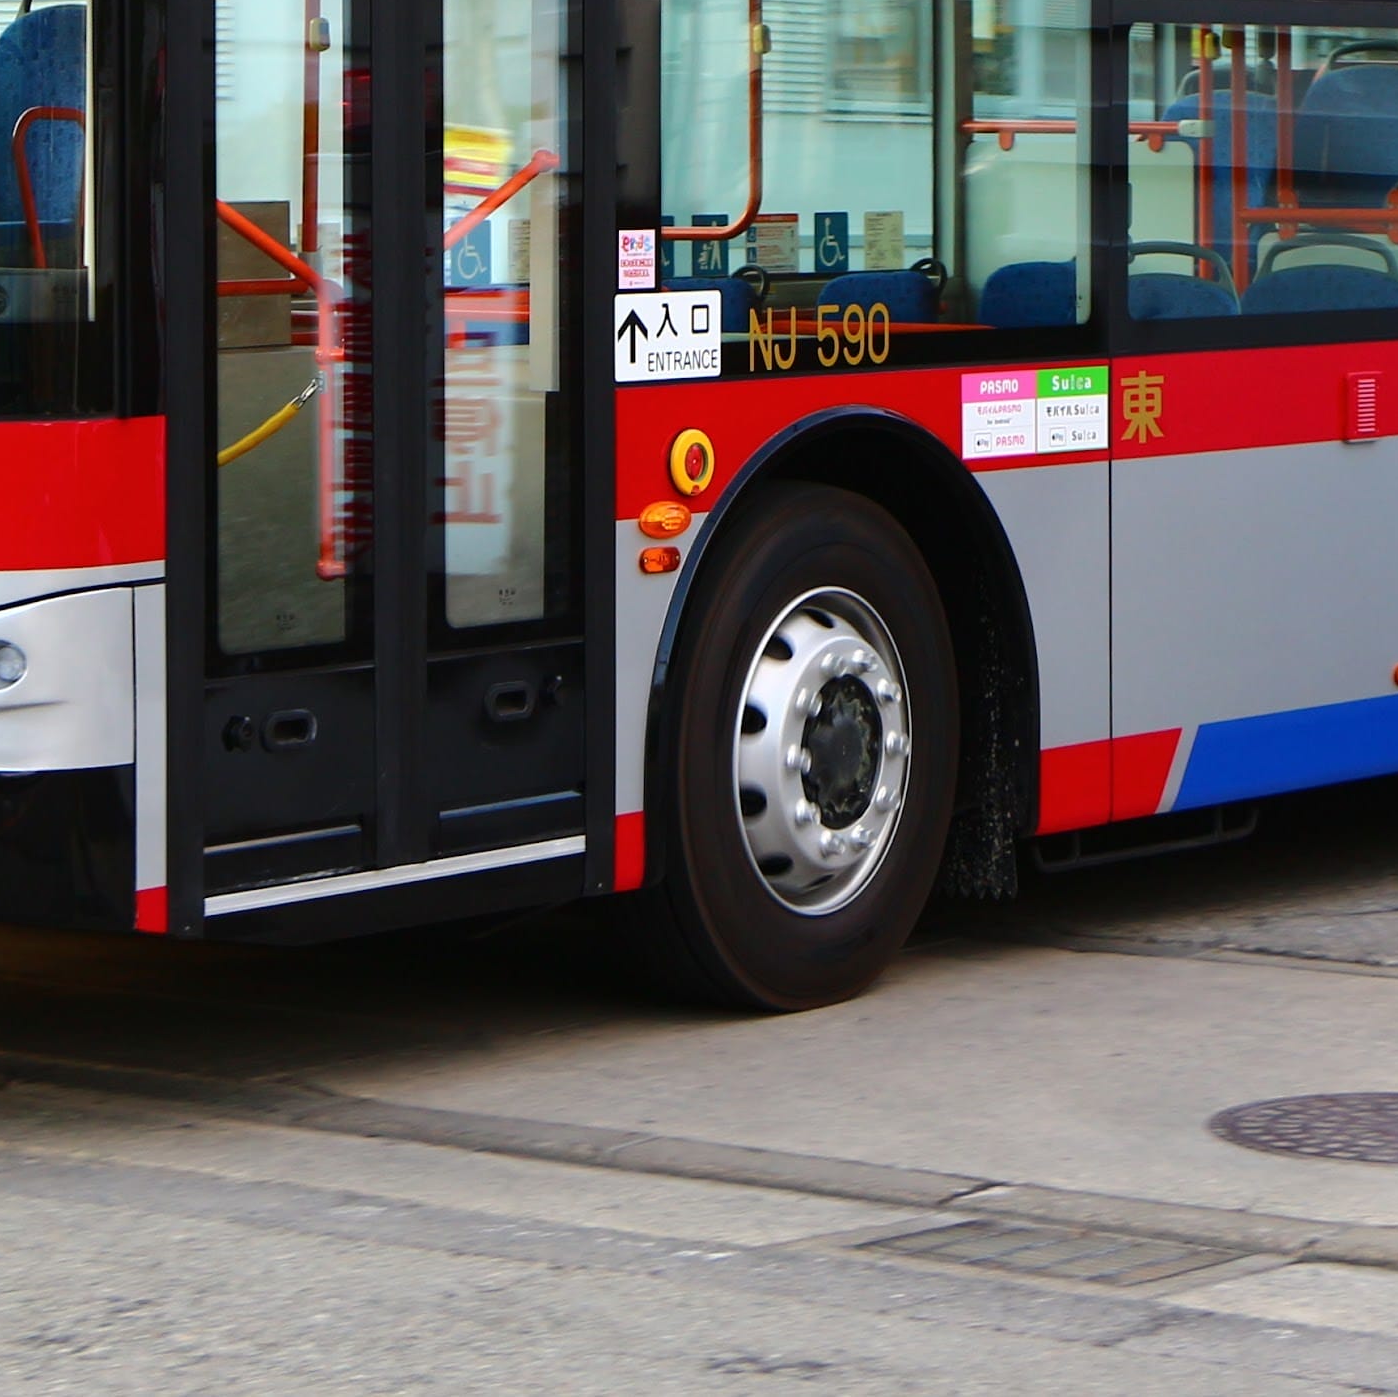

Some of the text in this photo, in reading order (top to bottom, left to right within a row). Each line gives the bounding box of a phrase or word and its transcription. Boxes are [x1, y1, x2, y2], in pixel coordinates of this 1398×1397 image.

[656, 303, 710, 338] 入口
[749, 302, 890, 372] NJ 590
[648, 349, 718, 372] ENTRANCE
[980, 379, 1019, 394] PASMO
[1052, 374, 1092, 391] Suica
[1120, 370, 1164, 444] 東
[996, 435, 1025, 447] PASMO
[1072, 431, 1096, 441] Suica
